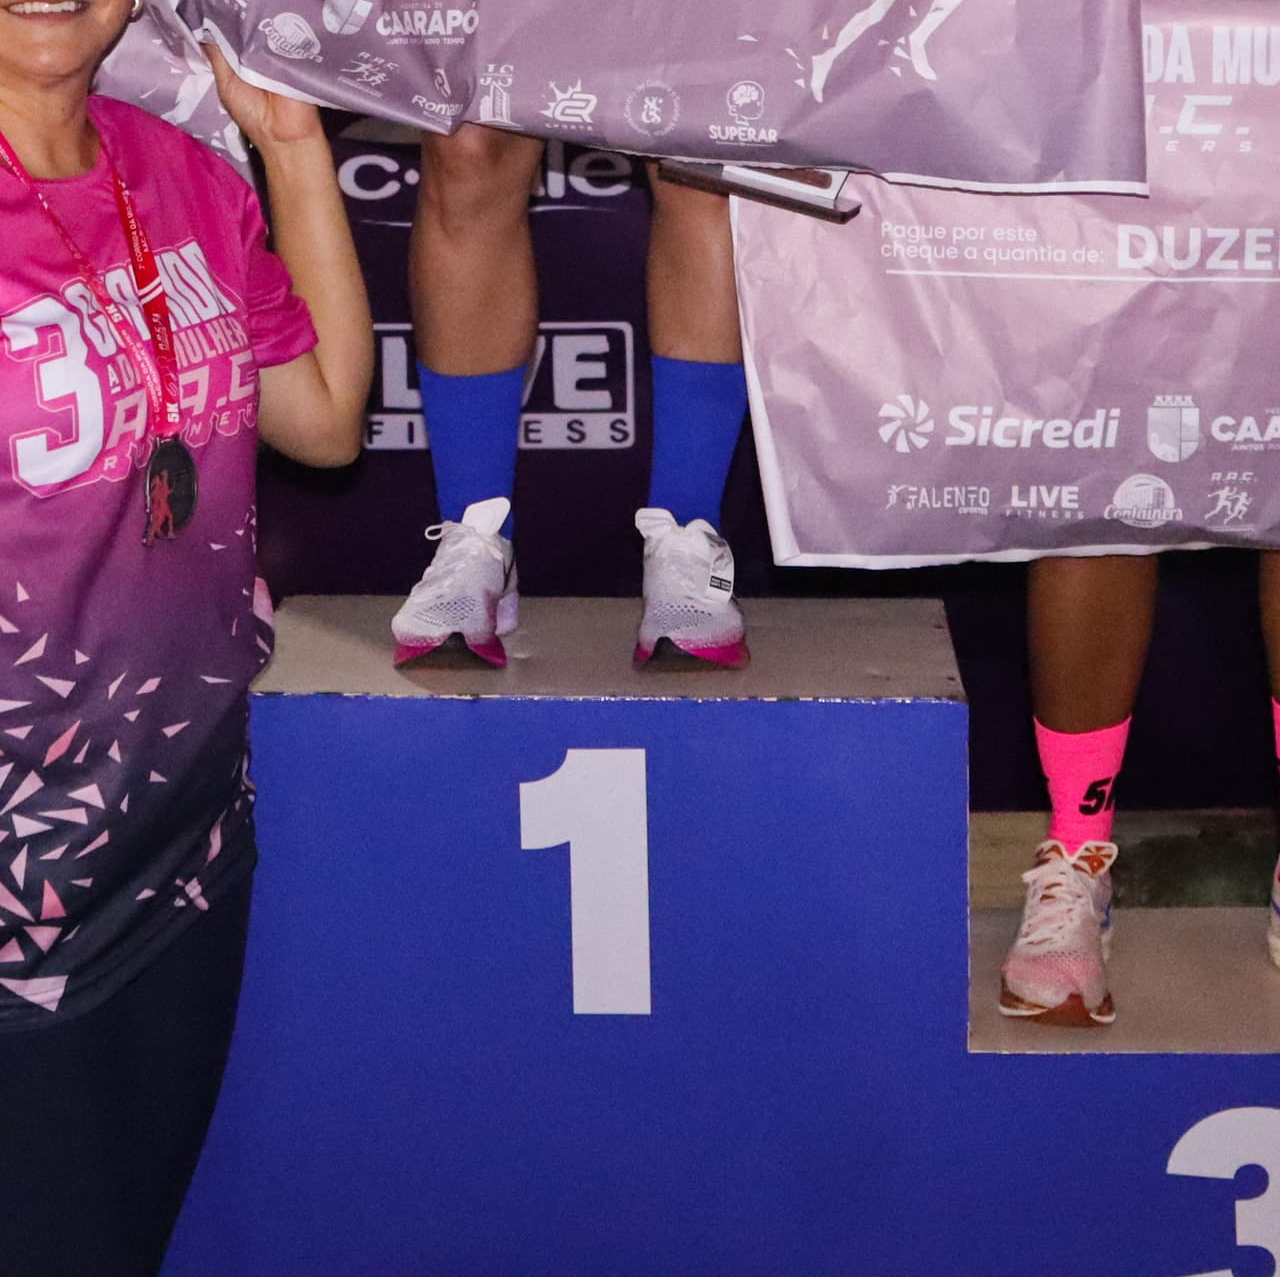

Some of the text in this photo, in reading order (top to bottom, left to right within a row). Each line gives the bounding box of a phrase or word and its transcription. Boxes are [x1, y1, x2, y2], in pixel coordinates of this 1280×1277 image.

[375, 1, 481, 37] CAARAPÓ
[708, 124, 780, 144] SUPERAR
[880, 221, 1038, 246] Pague por este
[879, 242, 1106, 266] cheque a quantia de:
[367, 419, 631, 445] FIESS
[944, 405, 1122, 450] Sicredi
[1010, 484, 1080, 509] LIVE
[518, 746, 652, 1016] 1
